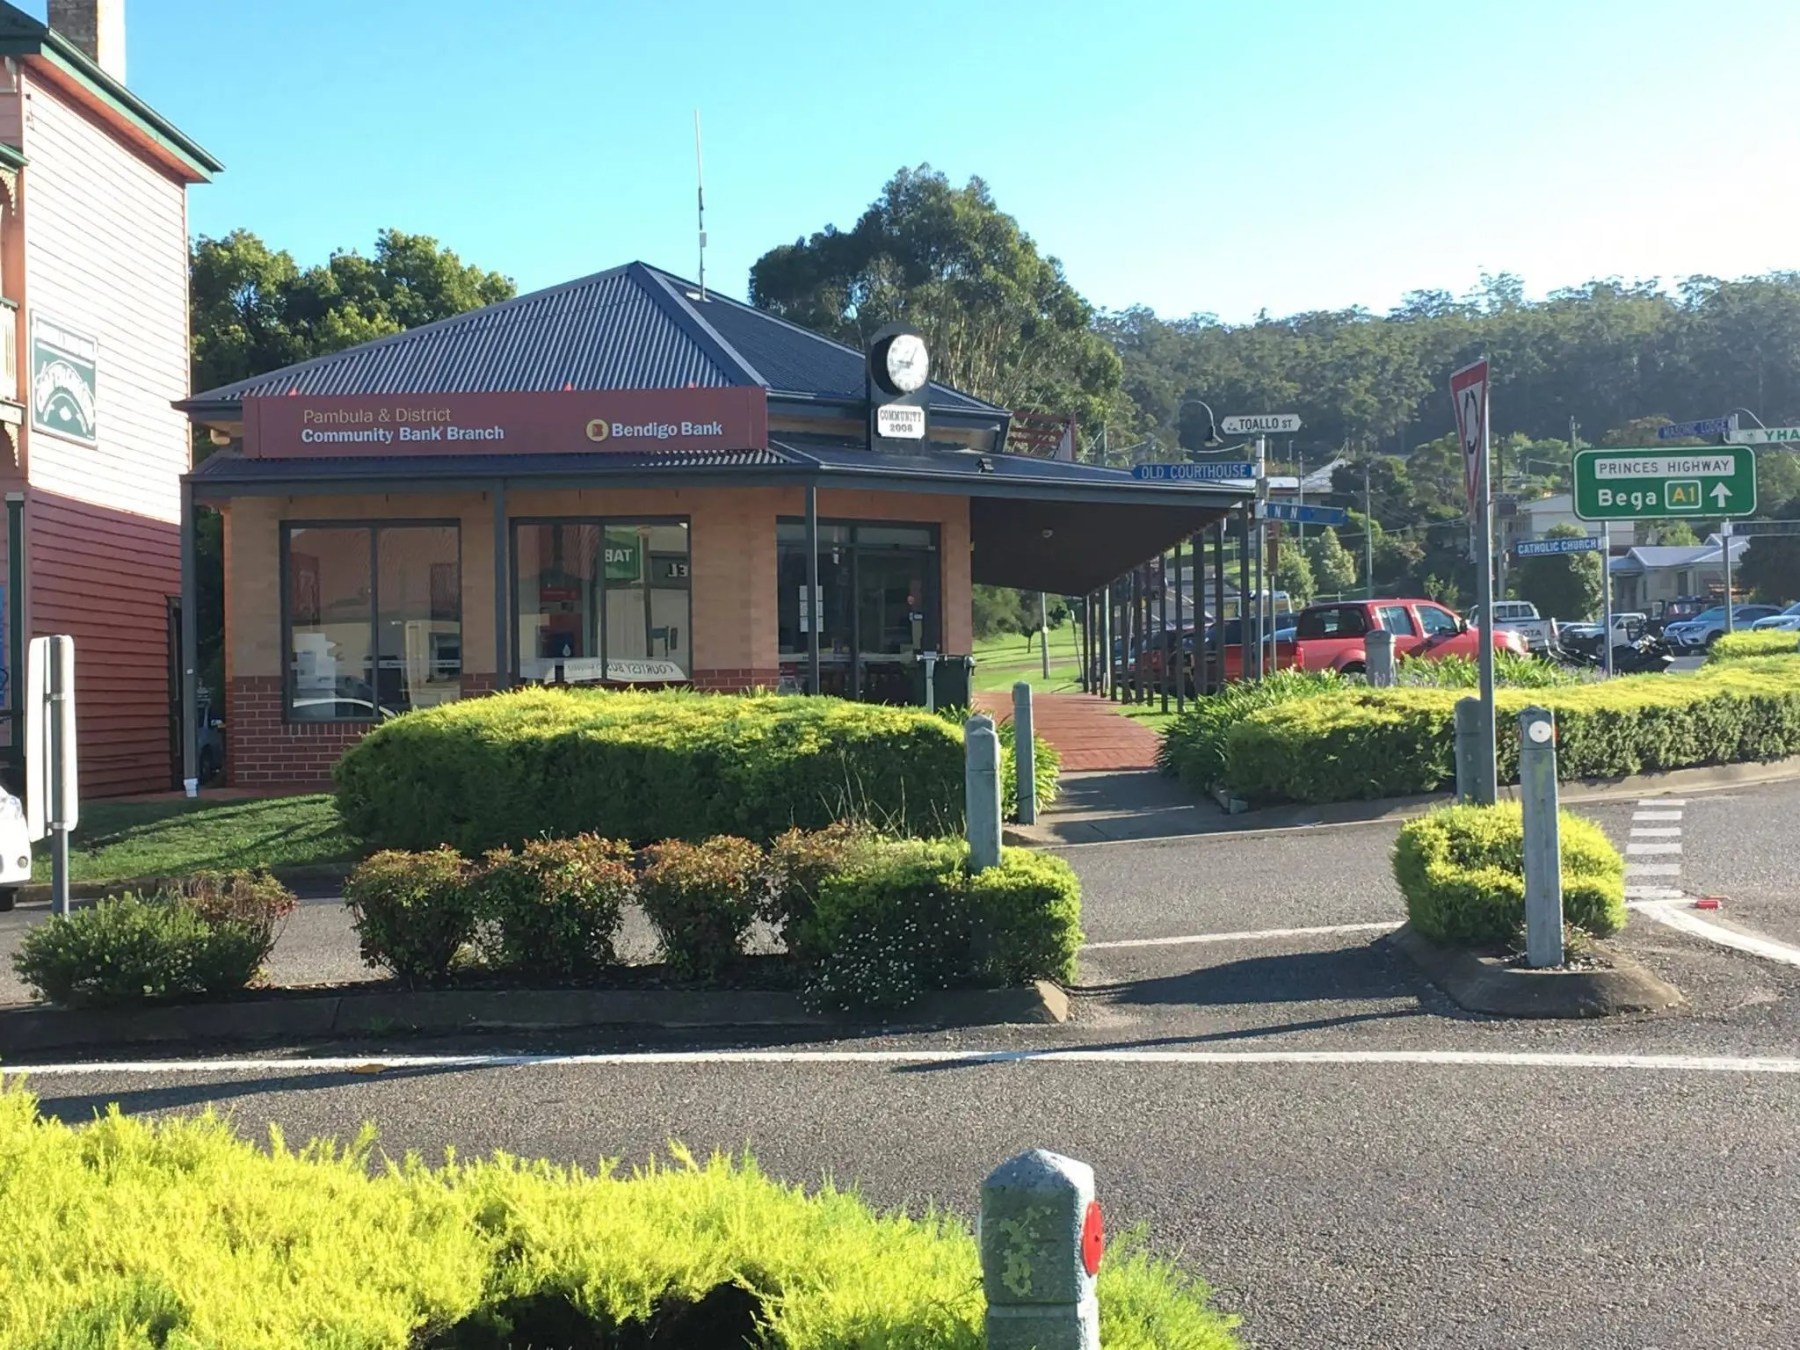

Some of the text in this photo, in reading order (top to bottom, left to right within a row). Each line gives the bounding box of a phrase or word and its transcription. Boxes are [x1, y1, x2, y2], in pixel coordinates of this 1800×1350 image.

[304, 408, 451, 423] Pambula & District
[612, 421, 722, 439] Bendigo Bank
[1238, 417, 1292, 431] TOALLO ST
[301, 426, 504, 444] Community Bank Branch
[1141, 464, 1247, 479] OLD COURTHOUSE
[1599, 460, 1730, 475] PRINCES HIGHWAY
[1598, 487, 1695, 511] Bega A1
[1517, 538, 1597, 554] CATHOLIC CHURCH
